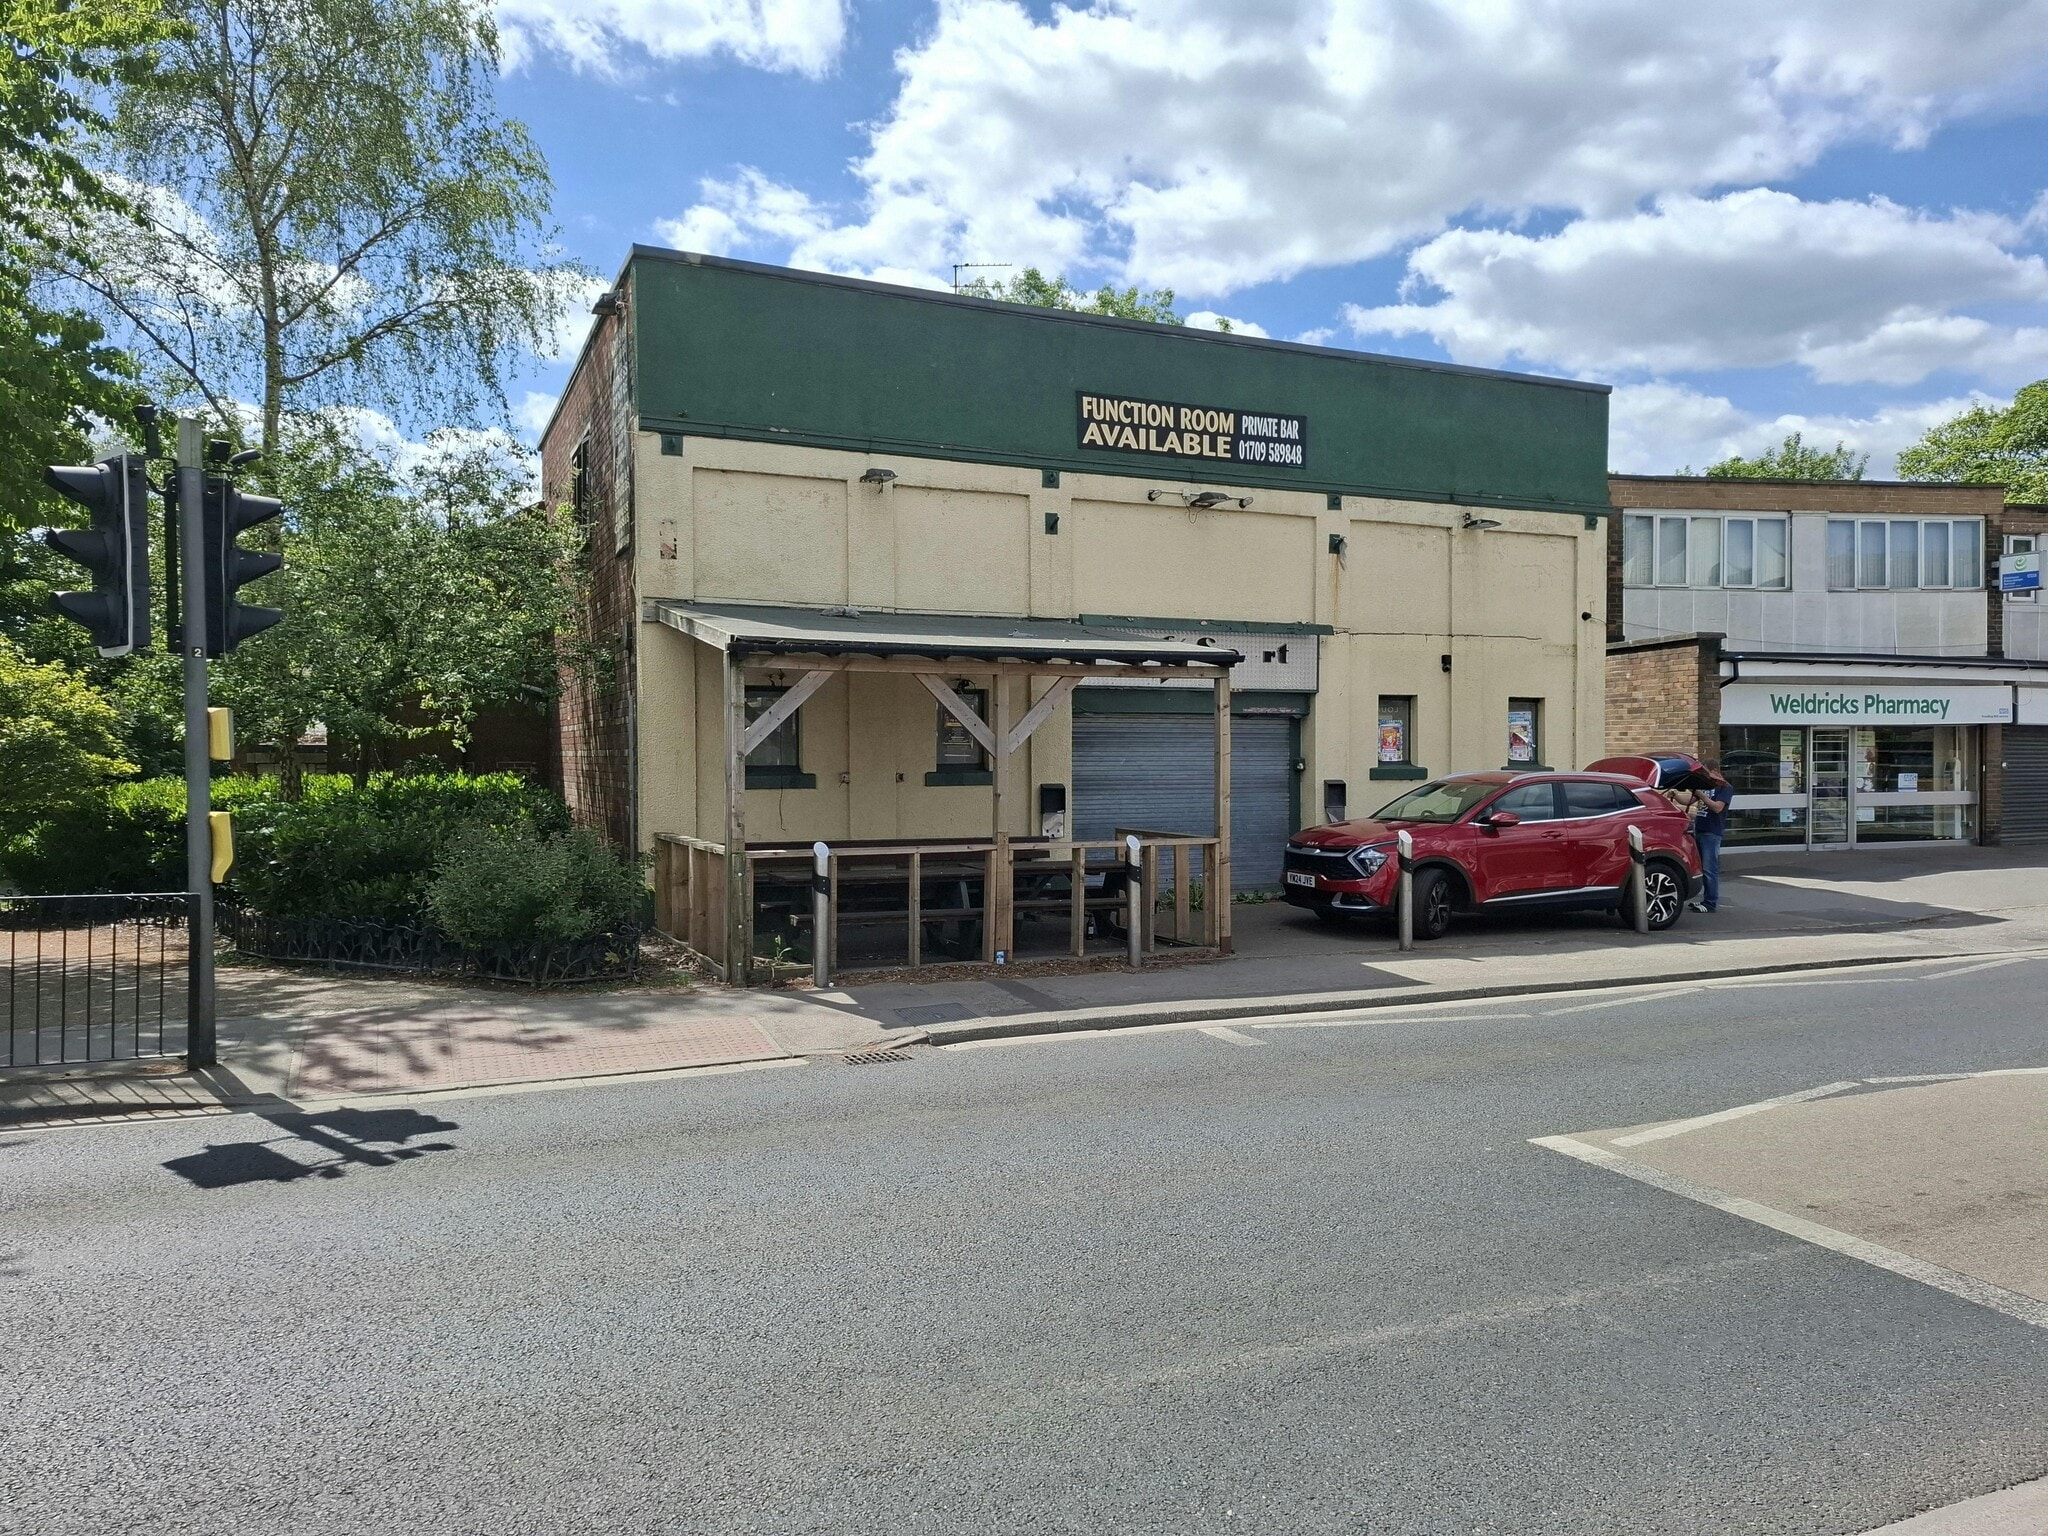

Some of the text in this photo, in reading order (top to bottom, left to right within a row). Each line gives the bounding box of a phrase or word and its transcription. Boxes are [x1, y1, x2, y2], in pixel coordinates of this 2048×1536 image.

[1082, 396, 1234, 434] FUNCTION ROOM
[1242, 415, 1299, 440] PRIVATE BAR
[1082, 422, 1232, 458] AVAILABLE
[1239, 440, 1302, 465] 01709 589848
[194, 647, 202, 658] 2
[1770, 692, 1951, 719] Weldricks Pharmacy
